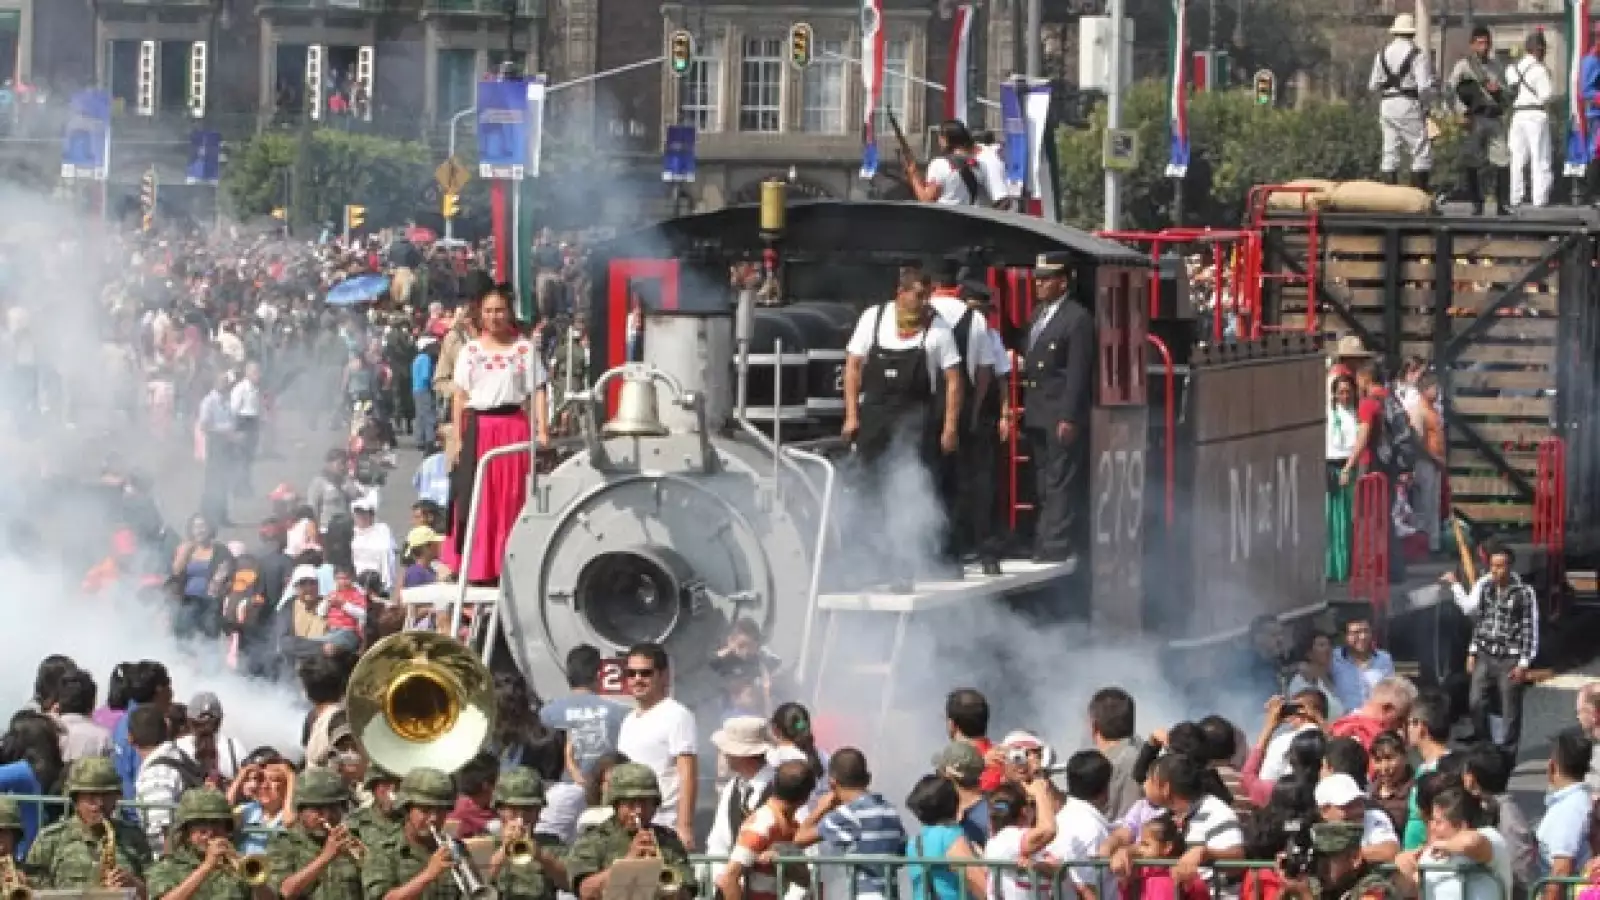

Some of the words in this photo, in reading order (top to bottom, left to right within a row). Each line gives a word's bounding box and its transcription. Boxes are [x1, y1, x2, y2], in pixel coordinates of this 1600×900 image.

[1096, 450, 1144, 544] 279
[1229, 463, 1252, 563] N
[1276, 453, 1300, 550] M
